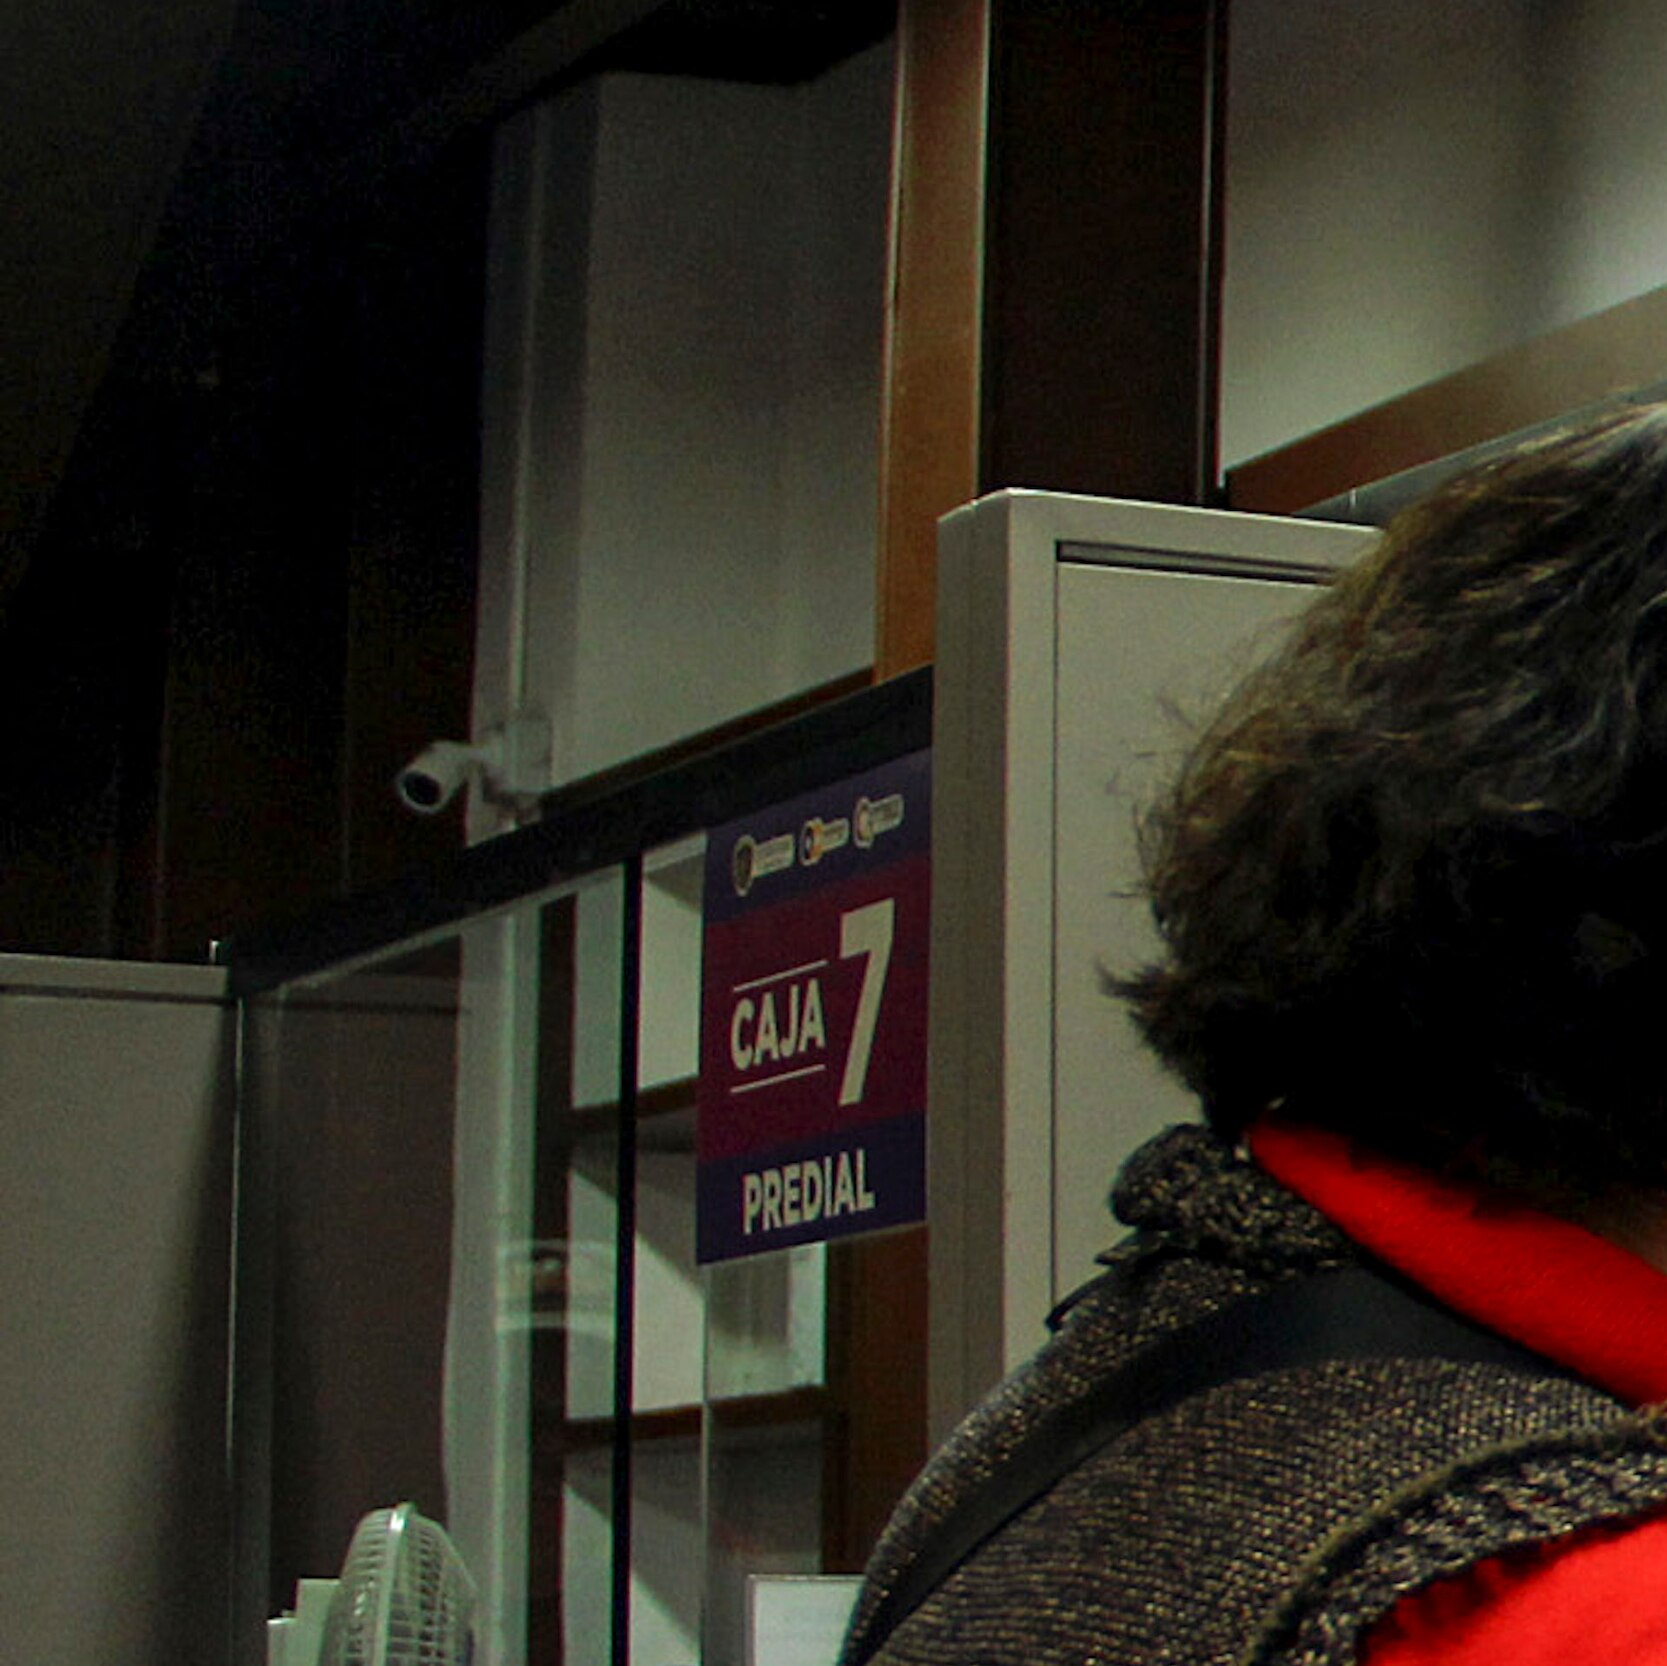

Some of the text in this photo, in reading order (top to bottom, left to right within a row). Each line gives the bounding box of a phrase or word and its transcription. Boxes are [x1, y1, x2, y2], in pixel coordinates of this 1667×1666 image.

[730, 897, 895, 1107] CAJA 7
[742, 1147, 876, 1236] PREDIAL
